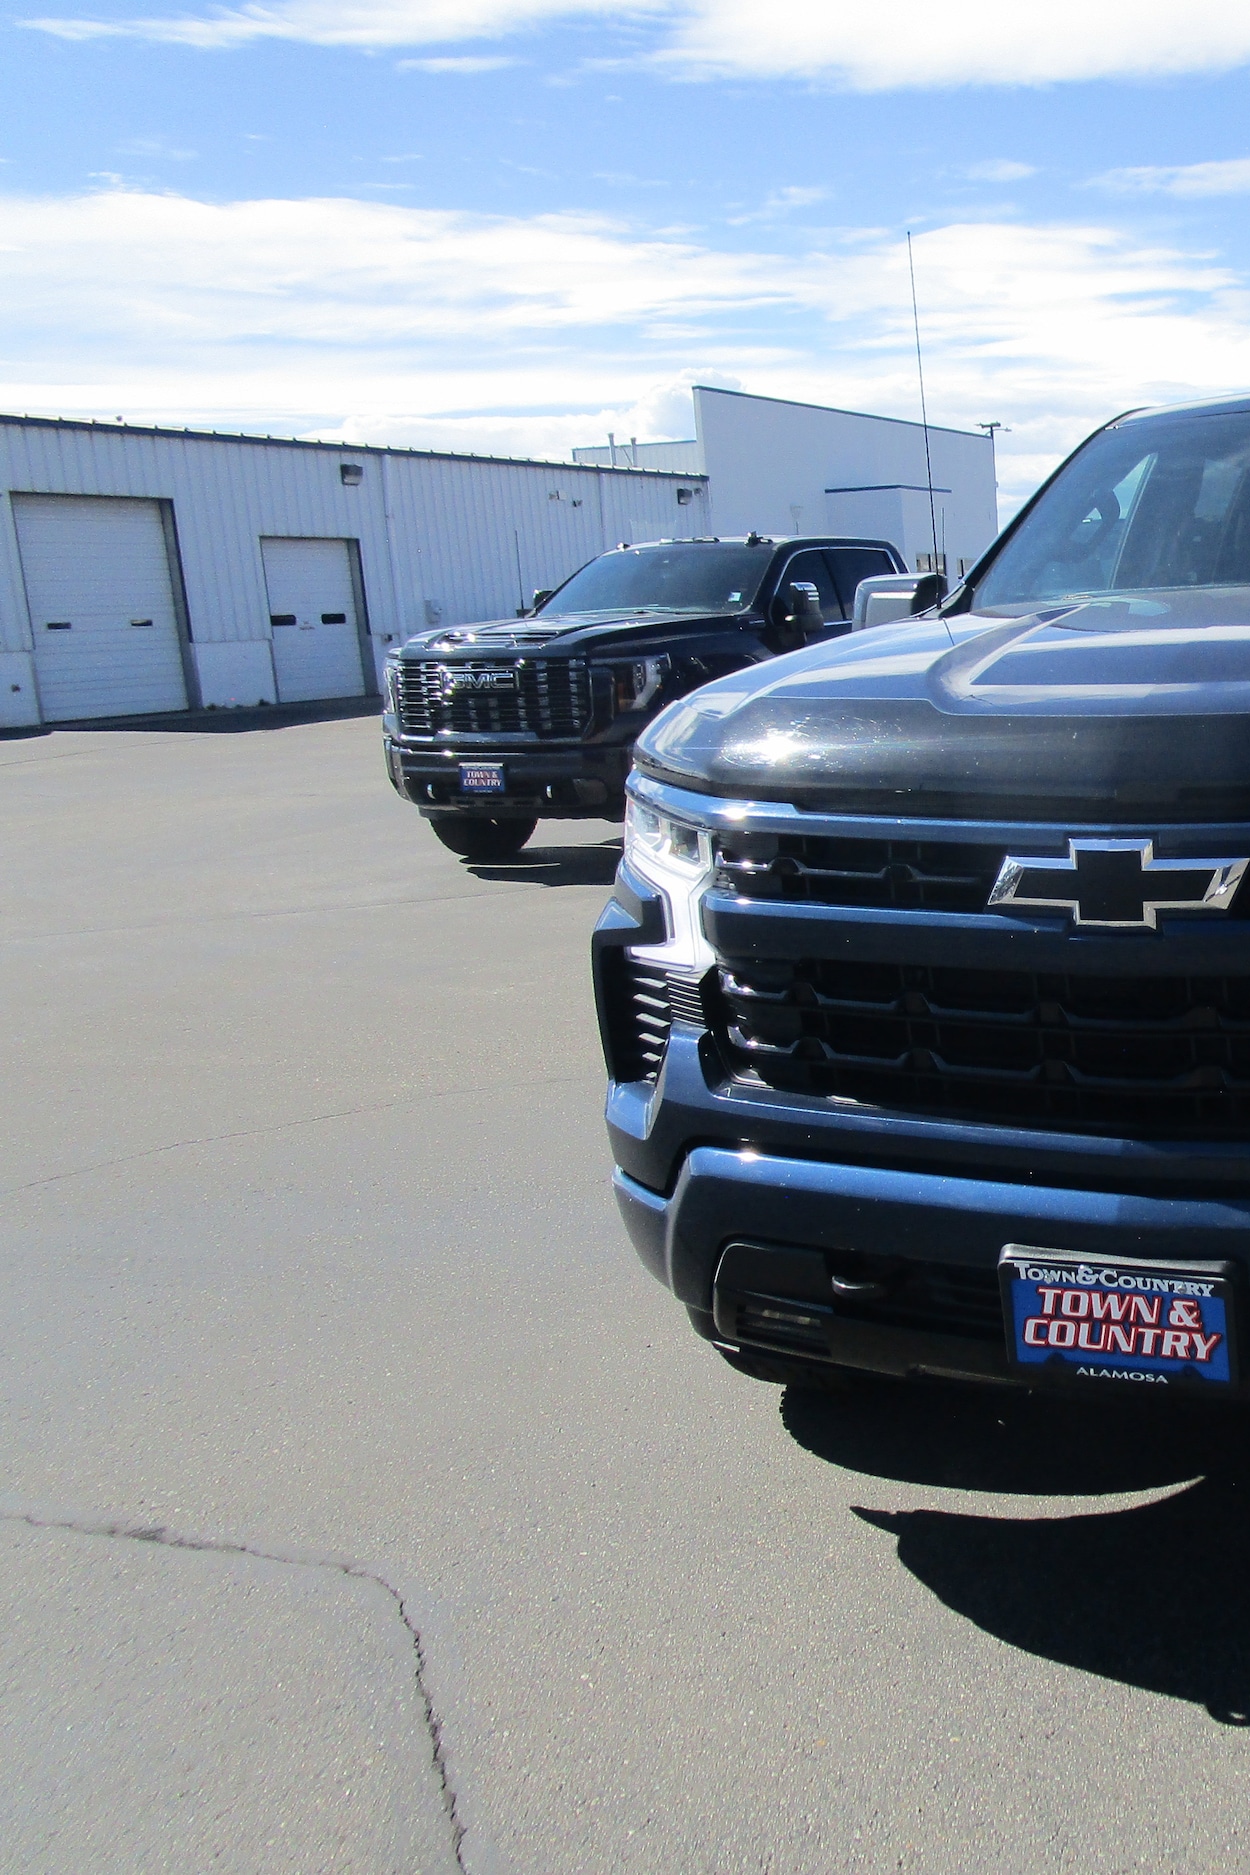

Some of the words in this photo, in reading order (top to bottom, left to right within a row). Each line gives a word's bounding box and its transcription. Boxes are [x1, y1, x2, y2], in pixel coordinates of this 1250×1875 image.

[444, 673, 514, 689] GMC
[1037, 1285, 1160, 1325] TOWN
[1168, 1299, 1202, 1329] &
[1023, 1317, 1221, 1361] COUNTRY
[1076, 1366, 1169, 1385] ALAMOSA
